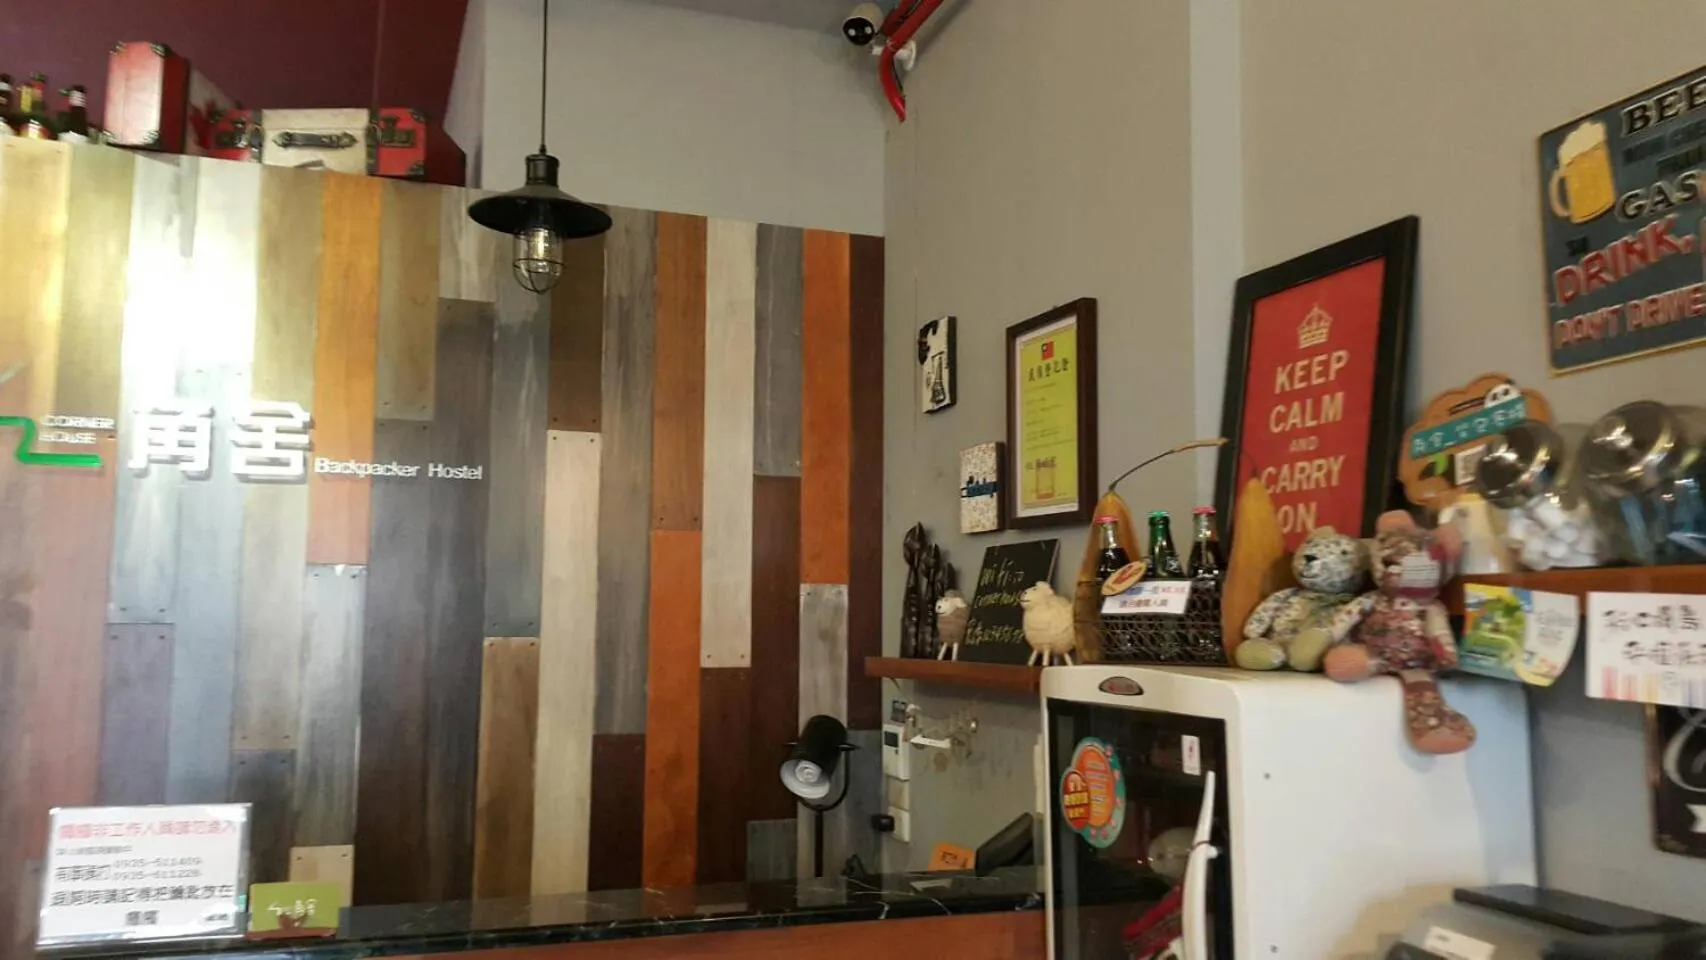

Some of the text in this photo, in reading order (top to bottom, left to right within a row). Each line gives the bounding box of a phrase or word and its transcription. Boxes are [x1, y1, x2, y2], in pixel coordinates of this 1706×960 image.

[1273, 350, 1349, 394] KEEP
[1268, 391, 1346, 434] CALM
[128, 400, 312, 480] 角舍
[1288, 435, 1319, 453] AND
[314, 456, 483, 480] Backpacker Hostel
[1260, 454, 1347, 495] CARRY
[1277, 503, 1318, 535] ON
